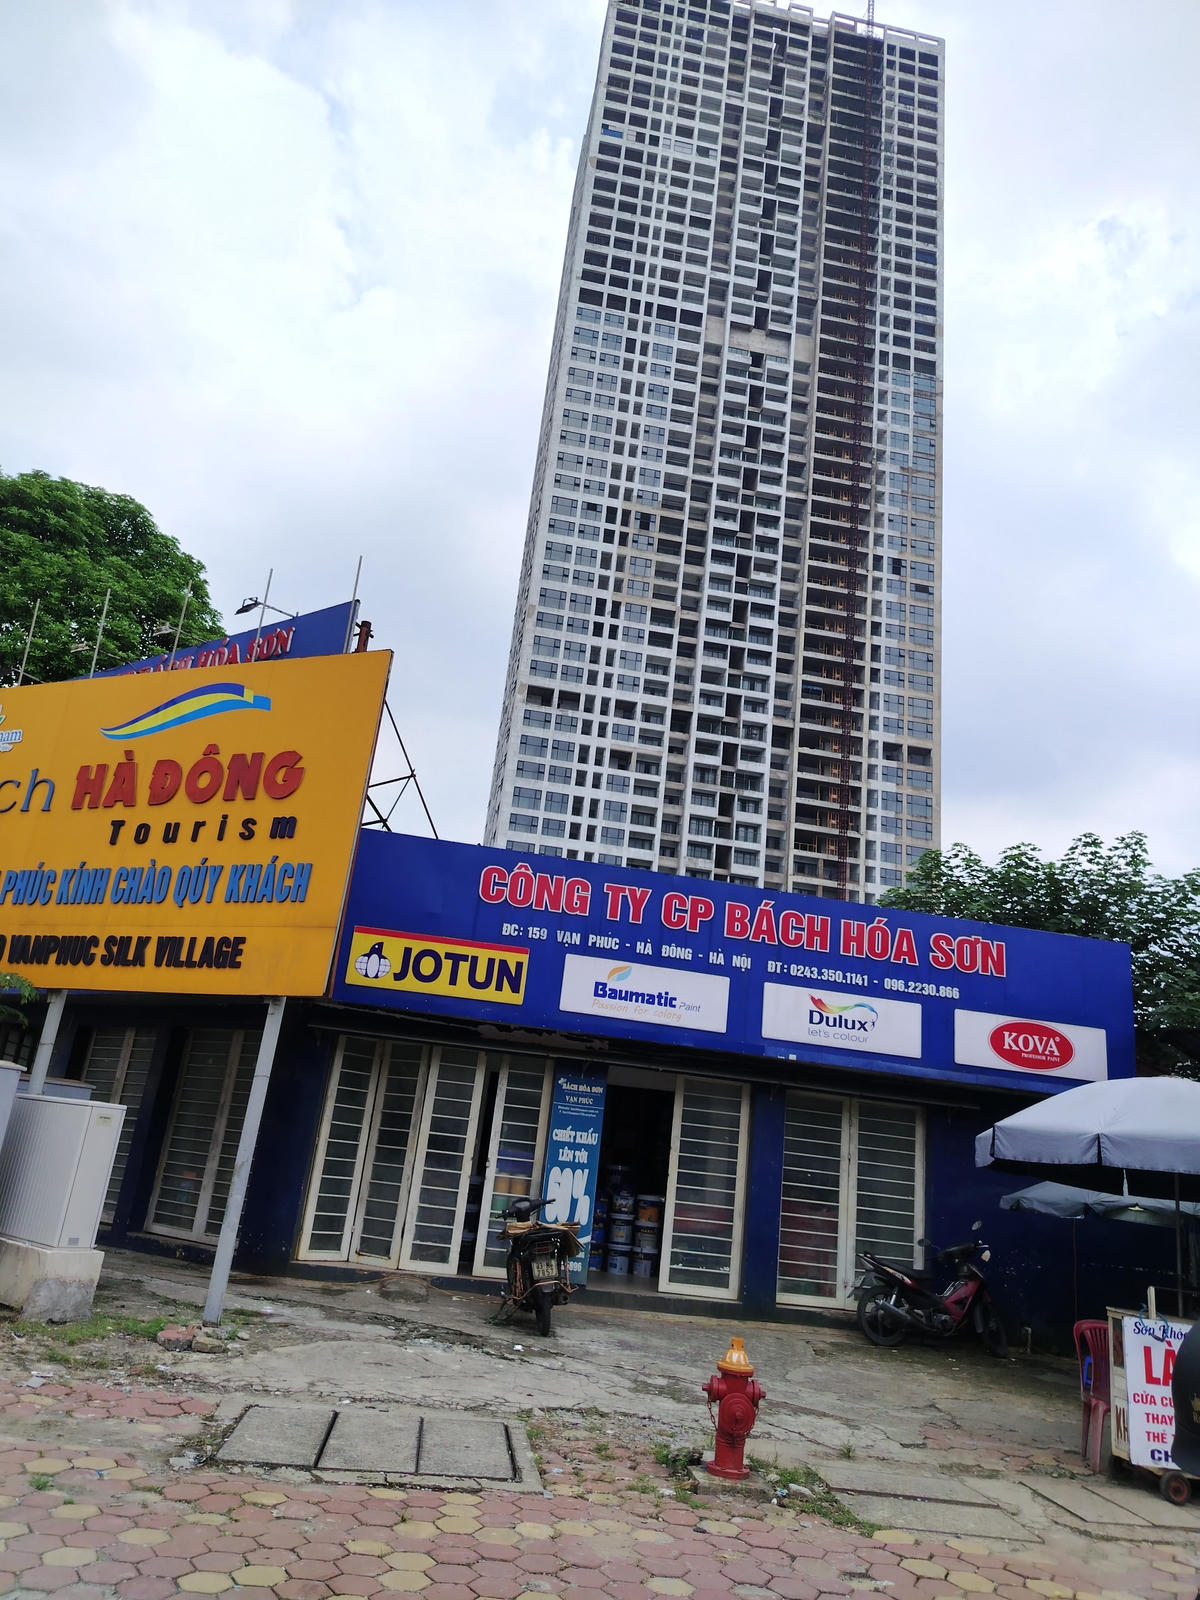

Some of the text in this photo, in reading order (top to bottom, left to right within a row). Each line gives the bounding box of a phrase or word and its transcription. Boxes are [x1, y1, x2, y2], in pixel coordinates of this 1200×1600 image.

[71, 749, 138, 811] HÀ
[109, 813, 298, 846] Tourism
[0, 861, 57, 906] PHÚC
[55, 861, 111, 905] KÍNH
[110, 858, 172, 905] CHÀO
[224, 855, 313, 904] KHÁCH
[478, 862, 1007, 978] CÔNG TY CP BÁCH HÓA SƠN
[100, 935, 152, 967] SILK
[154, 936, 247, 969] VILLAGE
[527, 926, 548, 940] 159
[556, 930, 581, 947] VẠN
[588, 931, 620, 950] PHÚC
[636, 938, 653, 955] HÀ
[661, 943, 693, 961] ĐÔNG
[708, 948, 725, 965] HÀ
[732, 954, 752, 972] NỘI
[790, 964, 869, 987] 0243.350.1141
[884, 978, 960, 999] 096.2230.866
[392, 947, 525, 994] JOTUN
[593, 981, 701, 1013] Baumatic Paint
[808, 1009, 869, 1033] Dulux
[808, 1027, 871, 1043] let's colour
[1145, 1412, 1174, 1426] THAY
